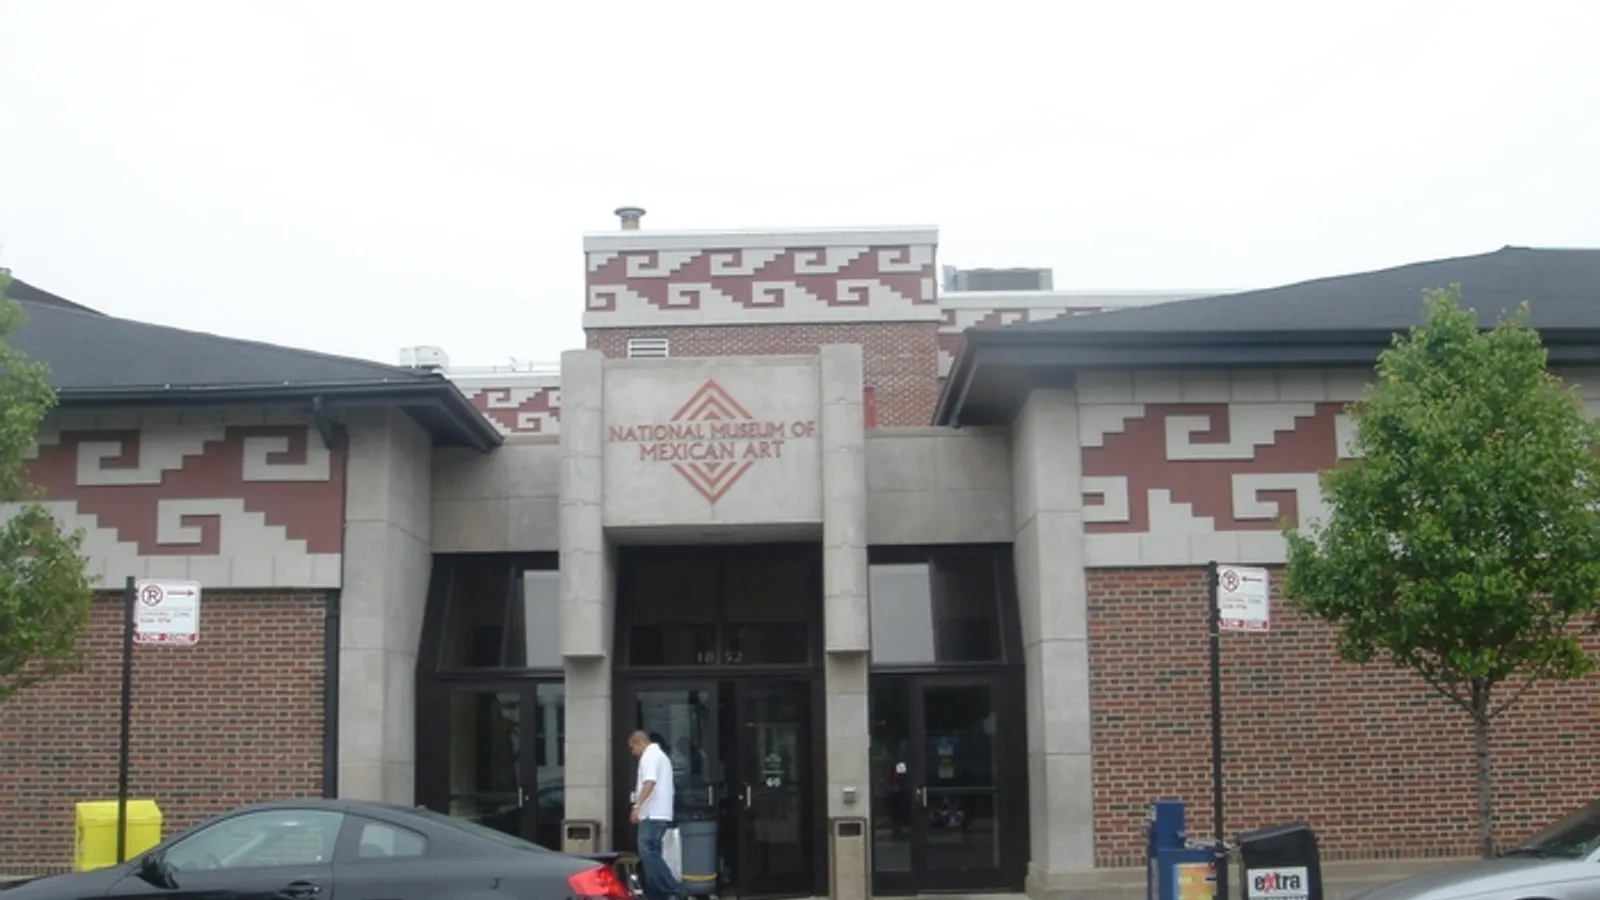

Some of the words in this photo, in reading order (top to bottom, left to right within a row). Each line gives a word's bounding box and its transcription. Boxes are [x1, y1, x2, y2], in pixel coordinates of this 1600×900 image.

[609, 424, 704, 442] NATIONAL
[709, 421, 785, 439] MUSEUM
[791, 420, 816, 437] OF
[639, 442, 735, 461] MEXICAN
[742, 440, 785, 459] ART
[1254, 871, 1301, 893] extra
